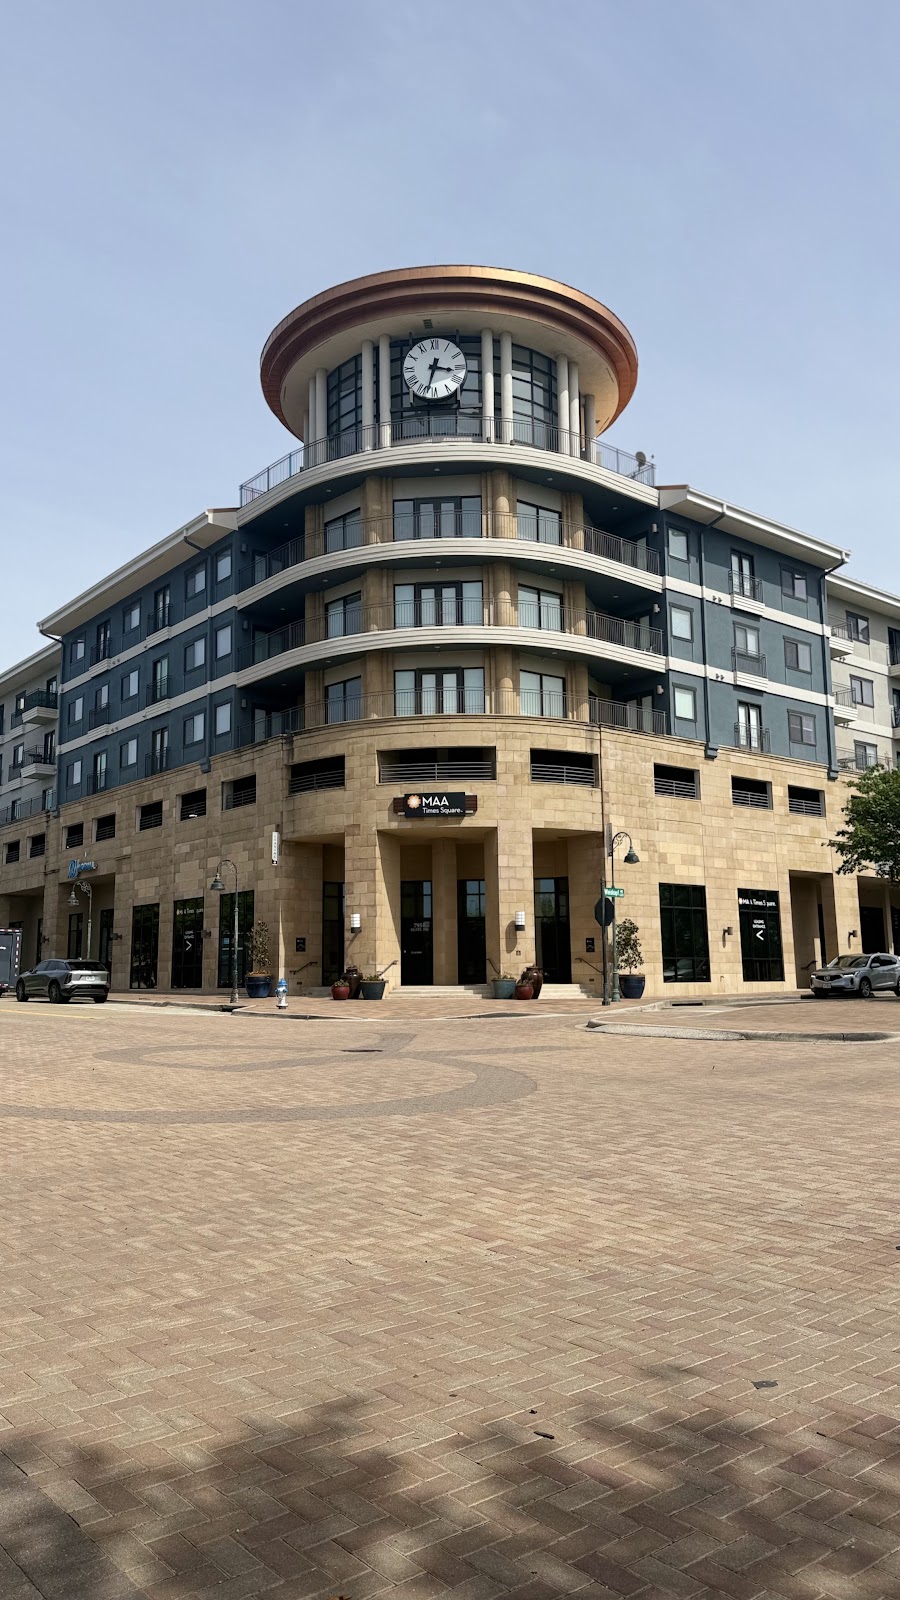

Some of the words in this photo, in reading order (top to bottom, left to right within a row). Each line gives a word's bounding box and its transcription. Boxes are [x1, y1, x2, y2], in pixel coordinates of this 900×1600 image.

[444, 342, 450, 352] I
[407, 353, 419, 362] X
[451, 351, 462, 360] II
[422, 796, 449, 806] MAA
